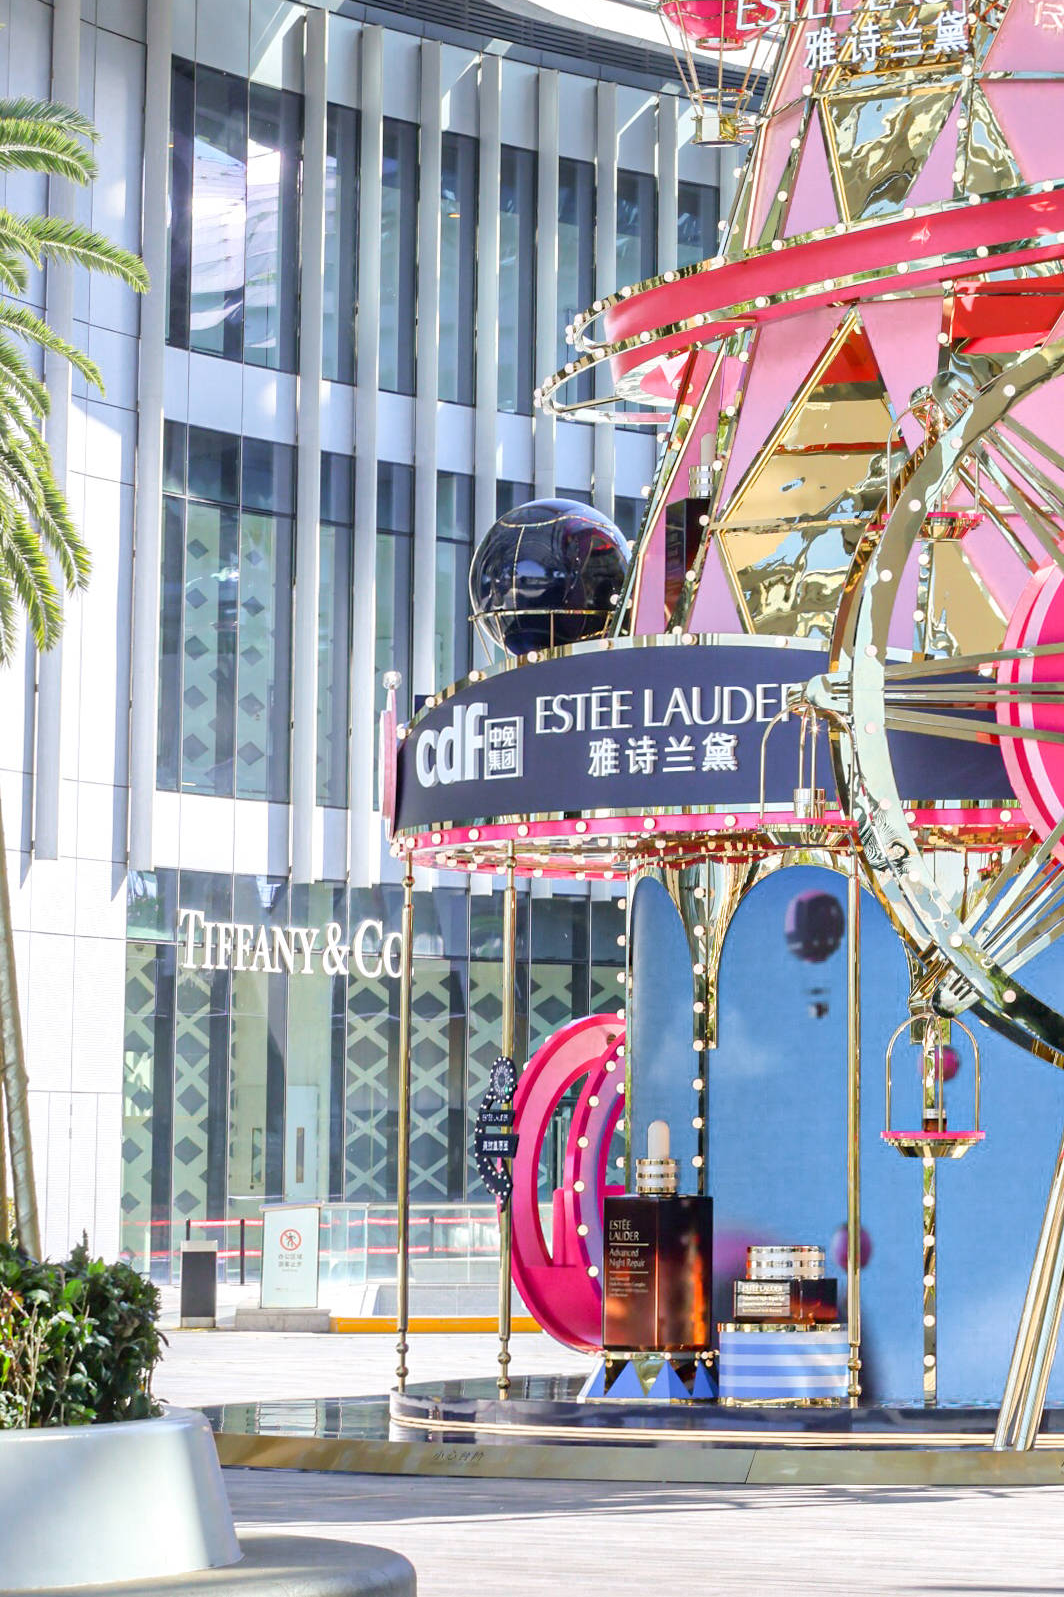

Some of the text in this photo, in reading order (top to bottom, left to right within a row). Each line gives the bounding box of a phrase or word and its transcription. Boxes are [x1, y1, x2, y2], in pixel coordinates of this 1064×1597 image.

[803, 10, 970, 71] 雅诗兰黛
[415, 702, 489, 788] cdf
[489, 725, 516, 748] 中免
[488, 748, 516, 771] 集团
[587, 731, 739, 778] 雅诗兰黛
[609, 1231, 640, 1242] LAUDER
